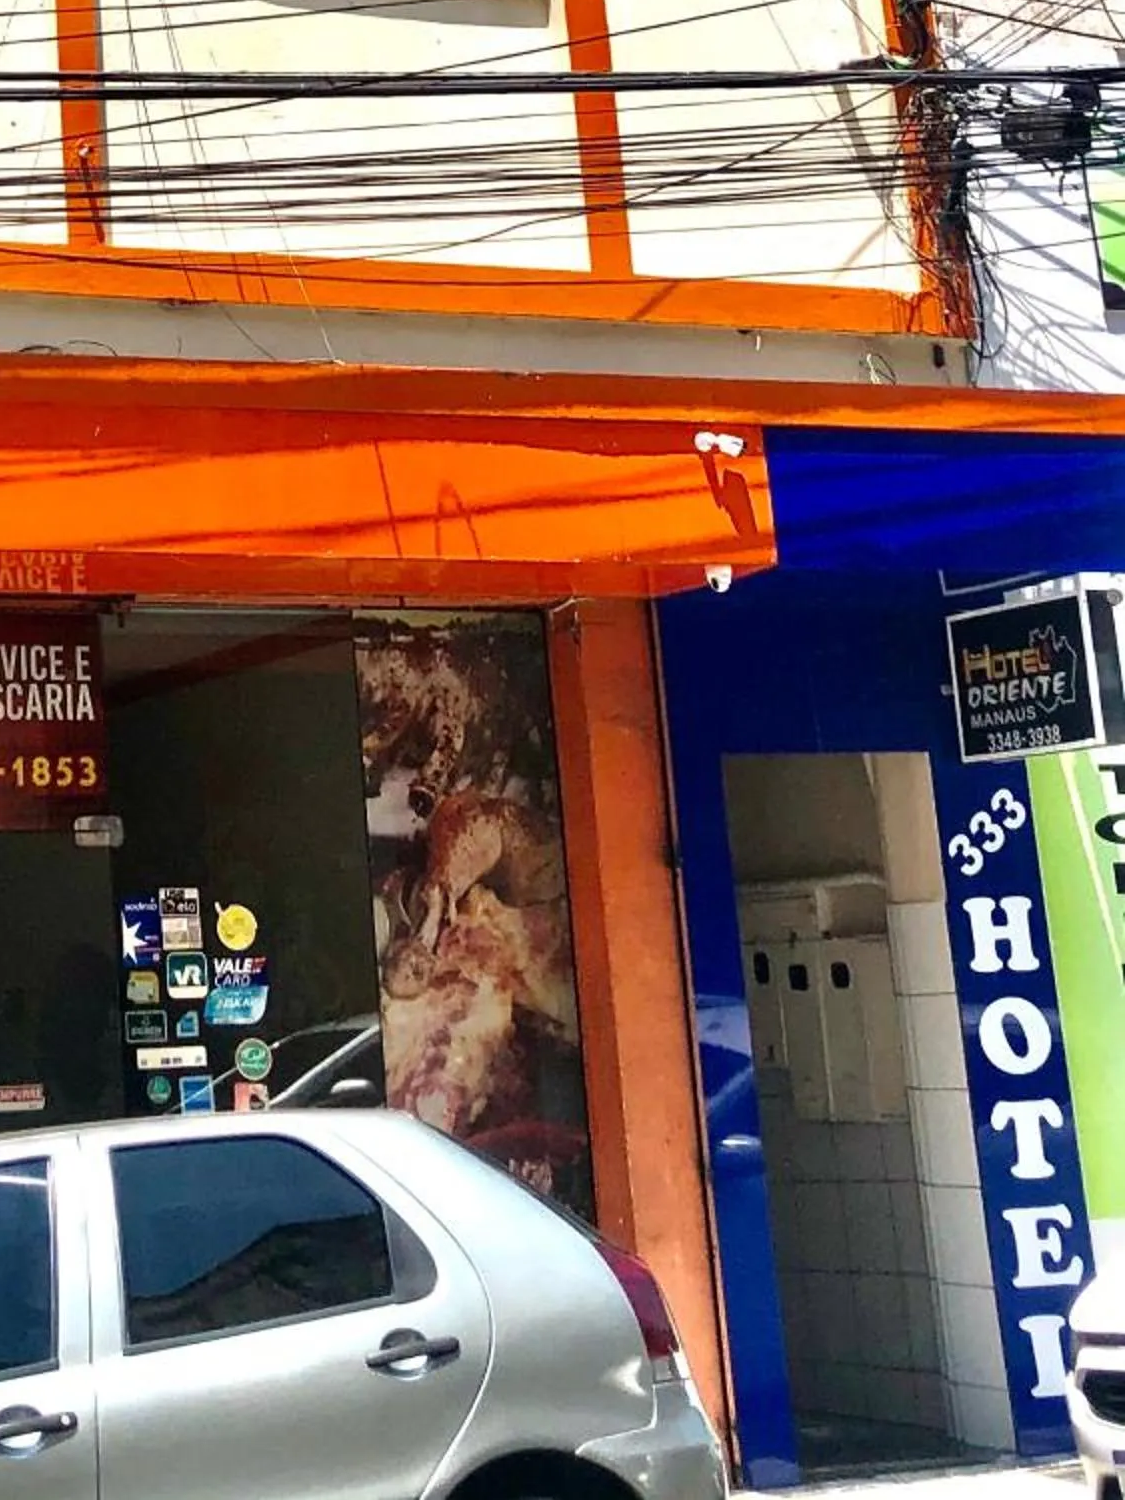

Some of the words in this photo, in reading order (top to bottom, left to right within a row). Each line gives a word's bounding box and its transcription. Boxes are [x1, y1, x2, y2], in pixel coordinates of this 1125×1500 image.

[75, 645, 92, 681] E
[962, 644, 1051, 684] HOTEL
[967, 671, 1067, 708] ORIENTE
[970, 705, 1037, 729] MANAUS
[987, 724, 1062, 753] 3348-3938
[948, 788, 1026, 876] 333
[214, 957, 253, 974] VALE
